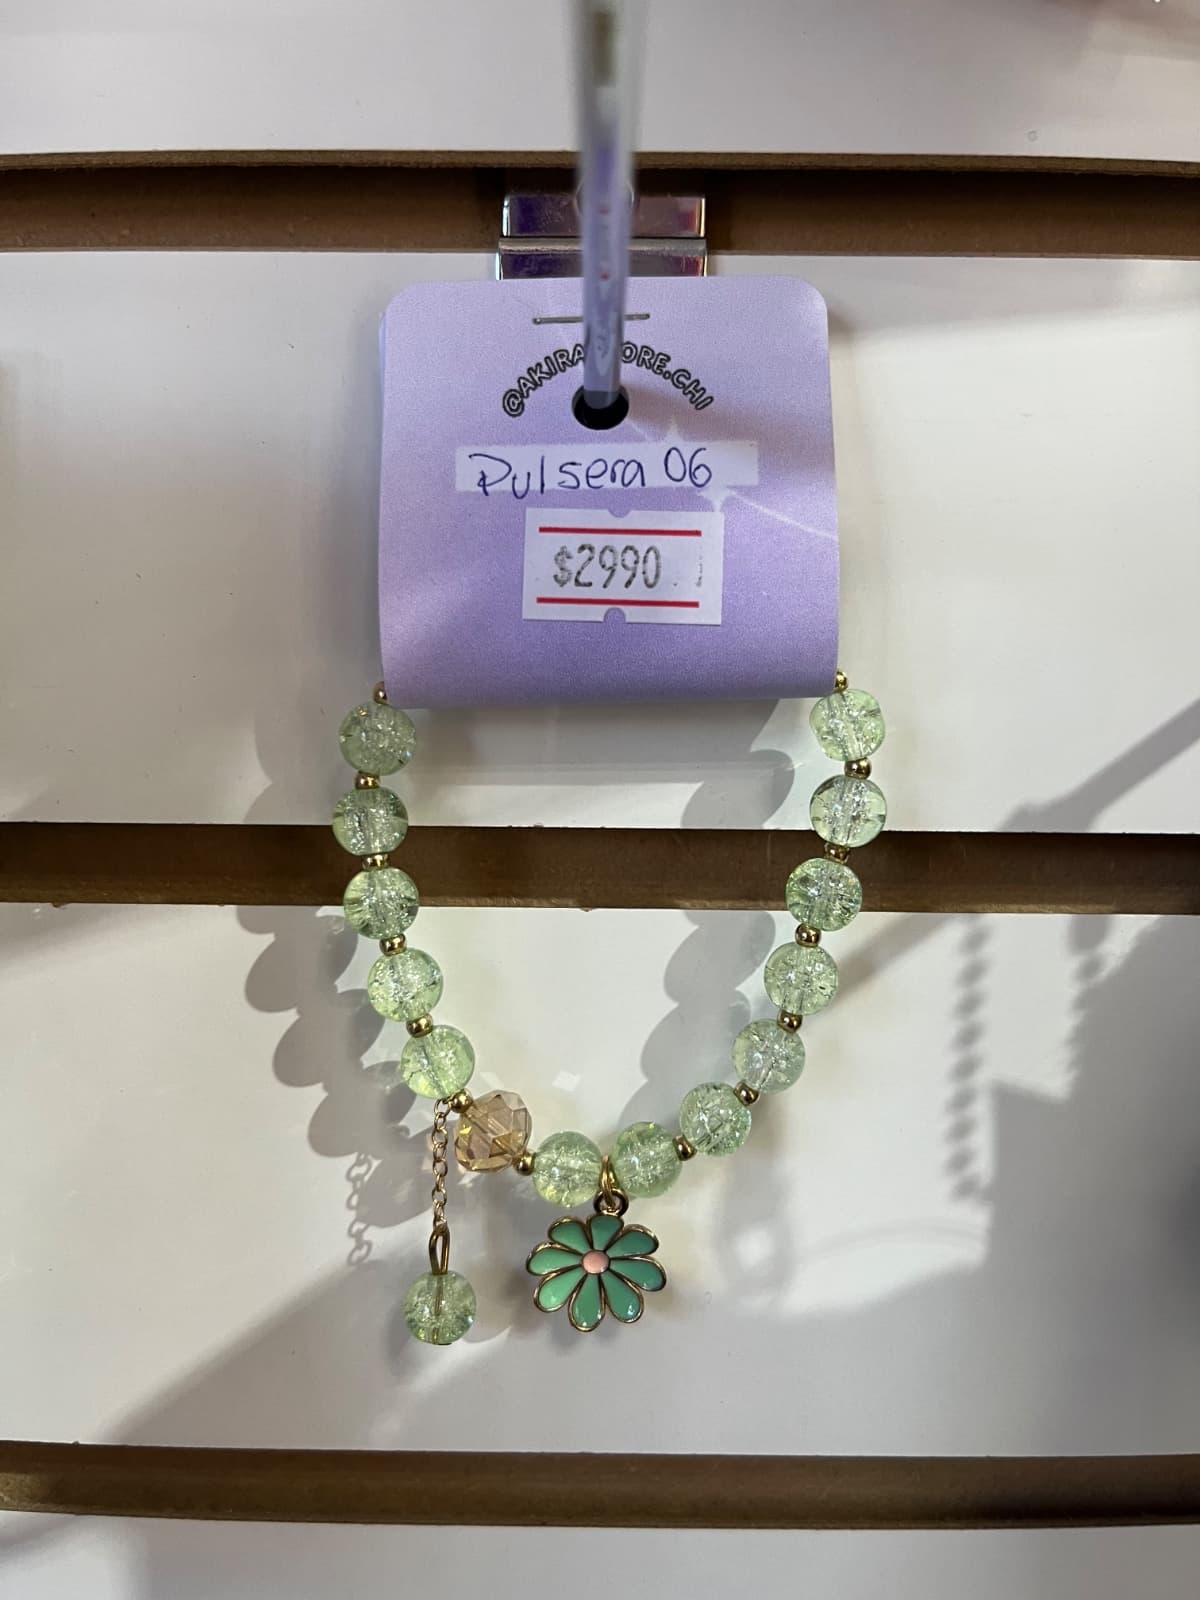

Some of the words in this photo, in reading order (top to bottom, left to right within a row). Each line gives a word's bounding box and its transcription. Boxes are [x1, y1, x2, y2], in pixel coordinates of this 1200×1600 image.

[502, 341, 714, 417] @AKIRAORE.CHI
[468, 452, 646, 499] Pulsera
[664, 447, 712, 488] 06
[553, 544, 661, 589] $2990
